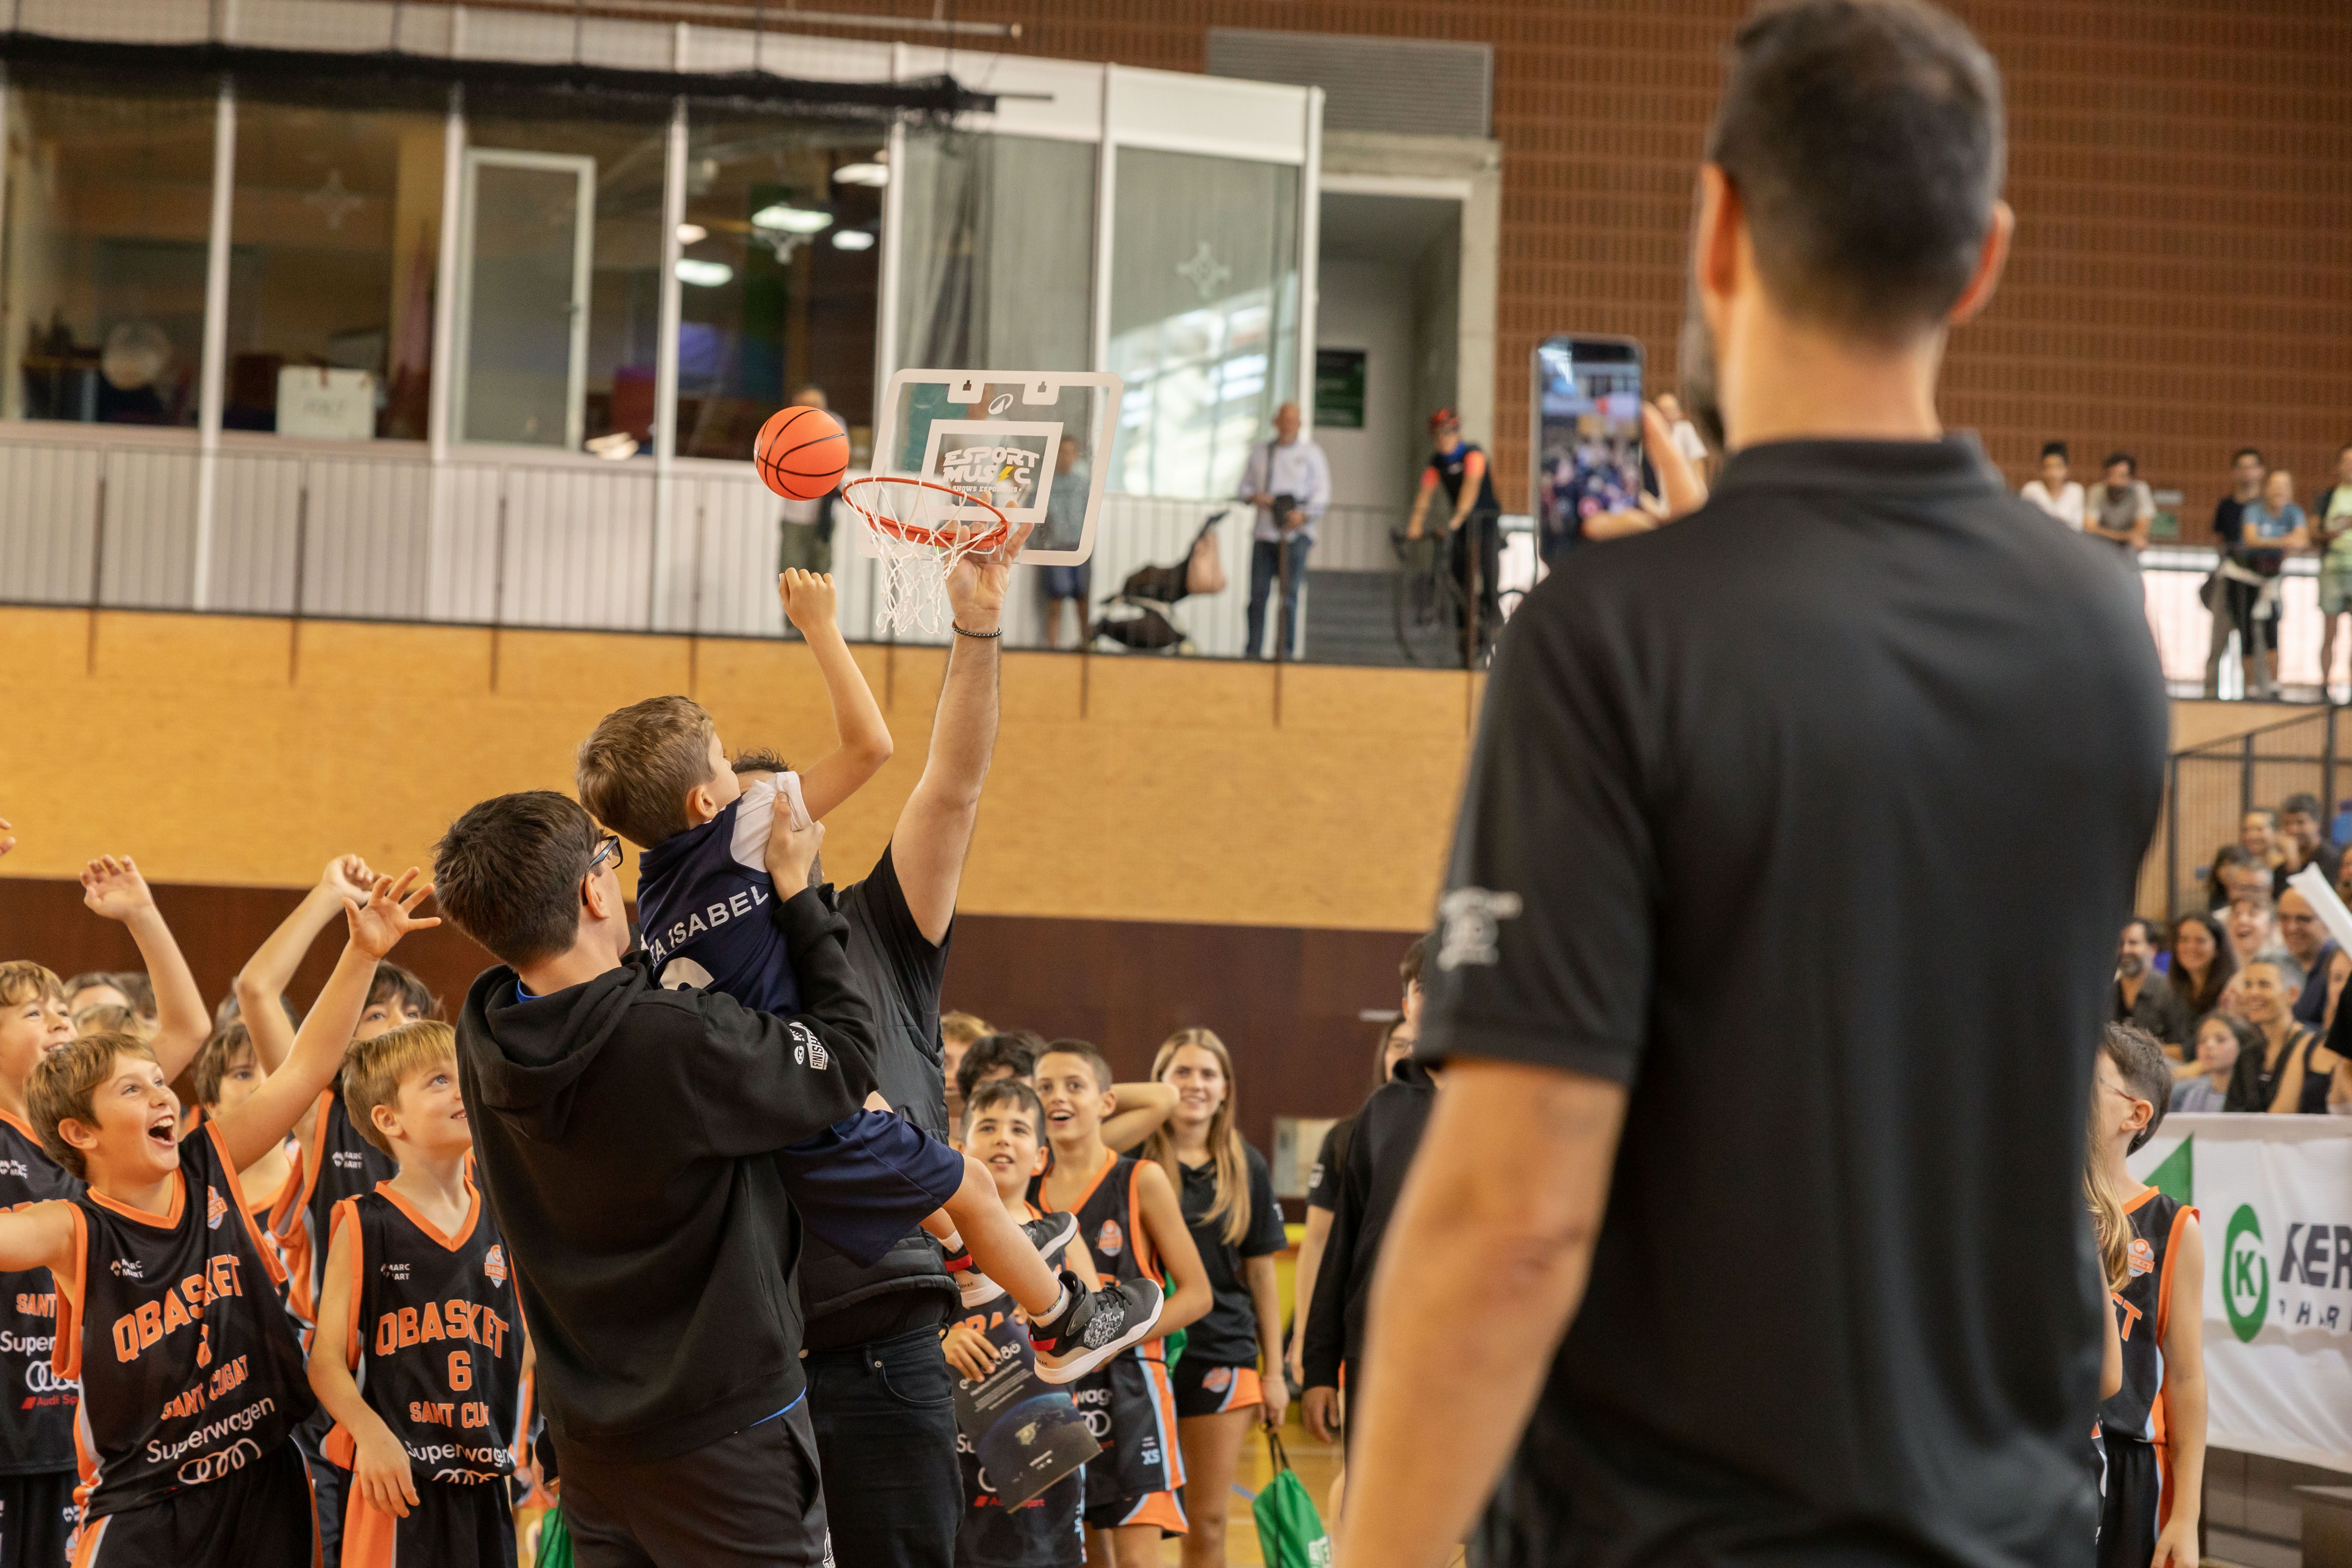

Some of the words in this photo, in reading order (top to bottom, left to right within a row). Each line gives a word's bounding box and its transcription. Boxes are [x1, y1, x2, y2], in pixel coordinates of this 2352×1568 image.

[942, 446, 1040, 468] ESPORT
[668, 886, 769, 948] ISABEL
[16, 1293, 56, 1318] SANT
[113, 1254, 243, 1363] QBASKET
[375, 1299, 509, 1358] QBASKET
[0, 1330, 56, 1357] Super
[160, 1383, 206, 1420] SANT
[209, 1354, 249, 1401] CUGAT
[448, 1350, 472, 1391] 6
[146, 1397, 275, 1463] Superwagen
[409, 1401, 455, 1428] SANT
